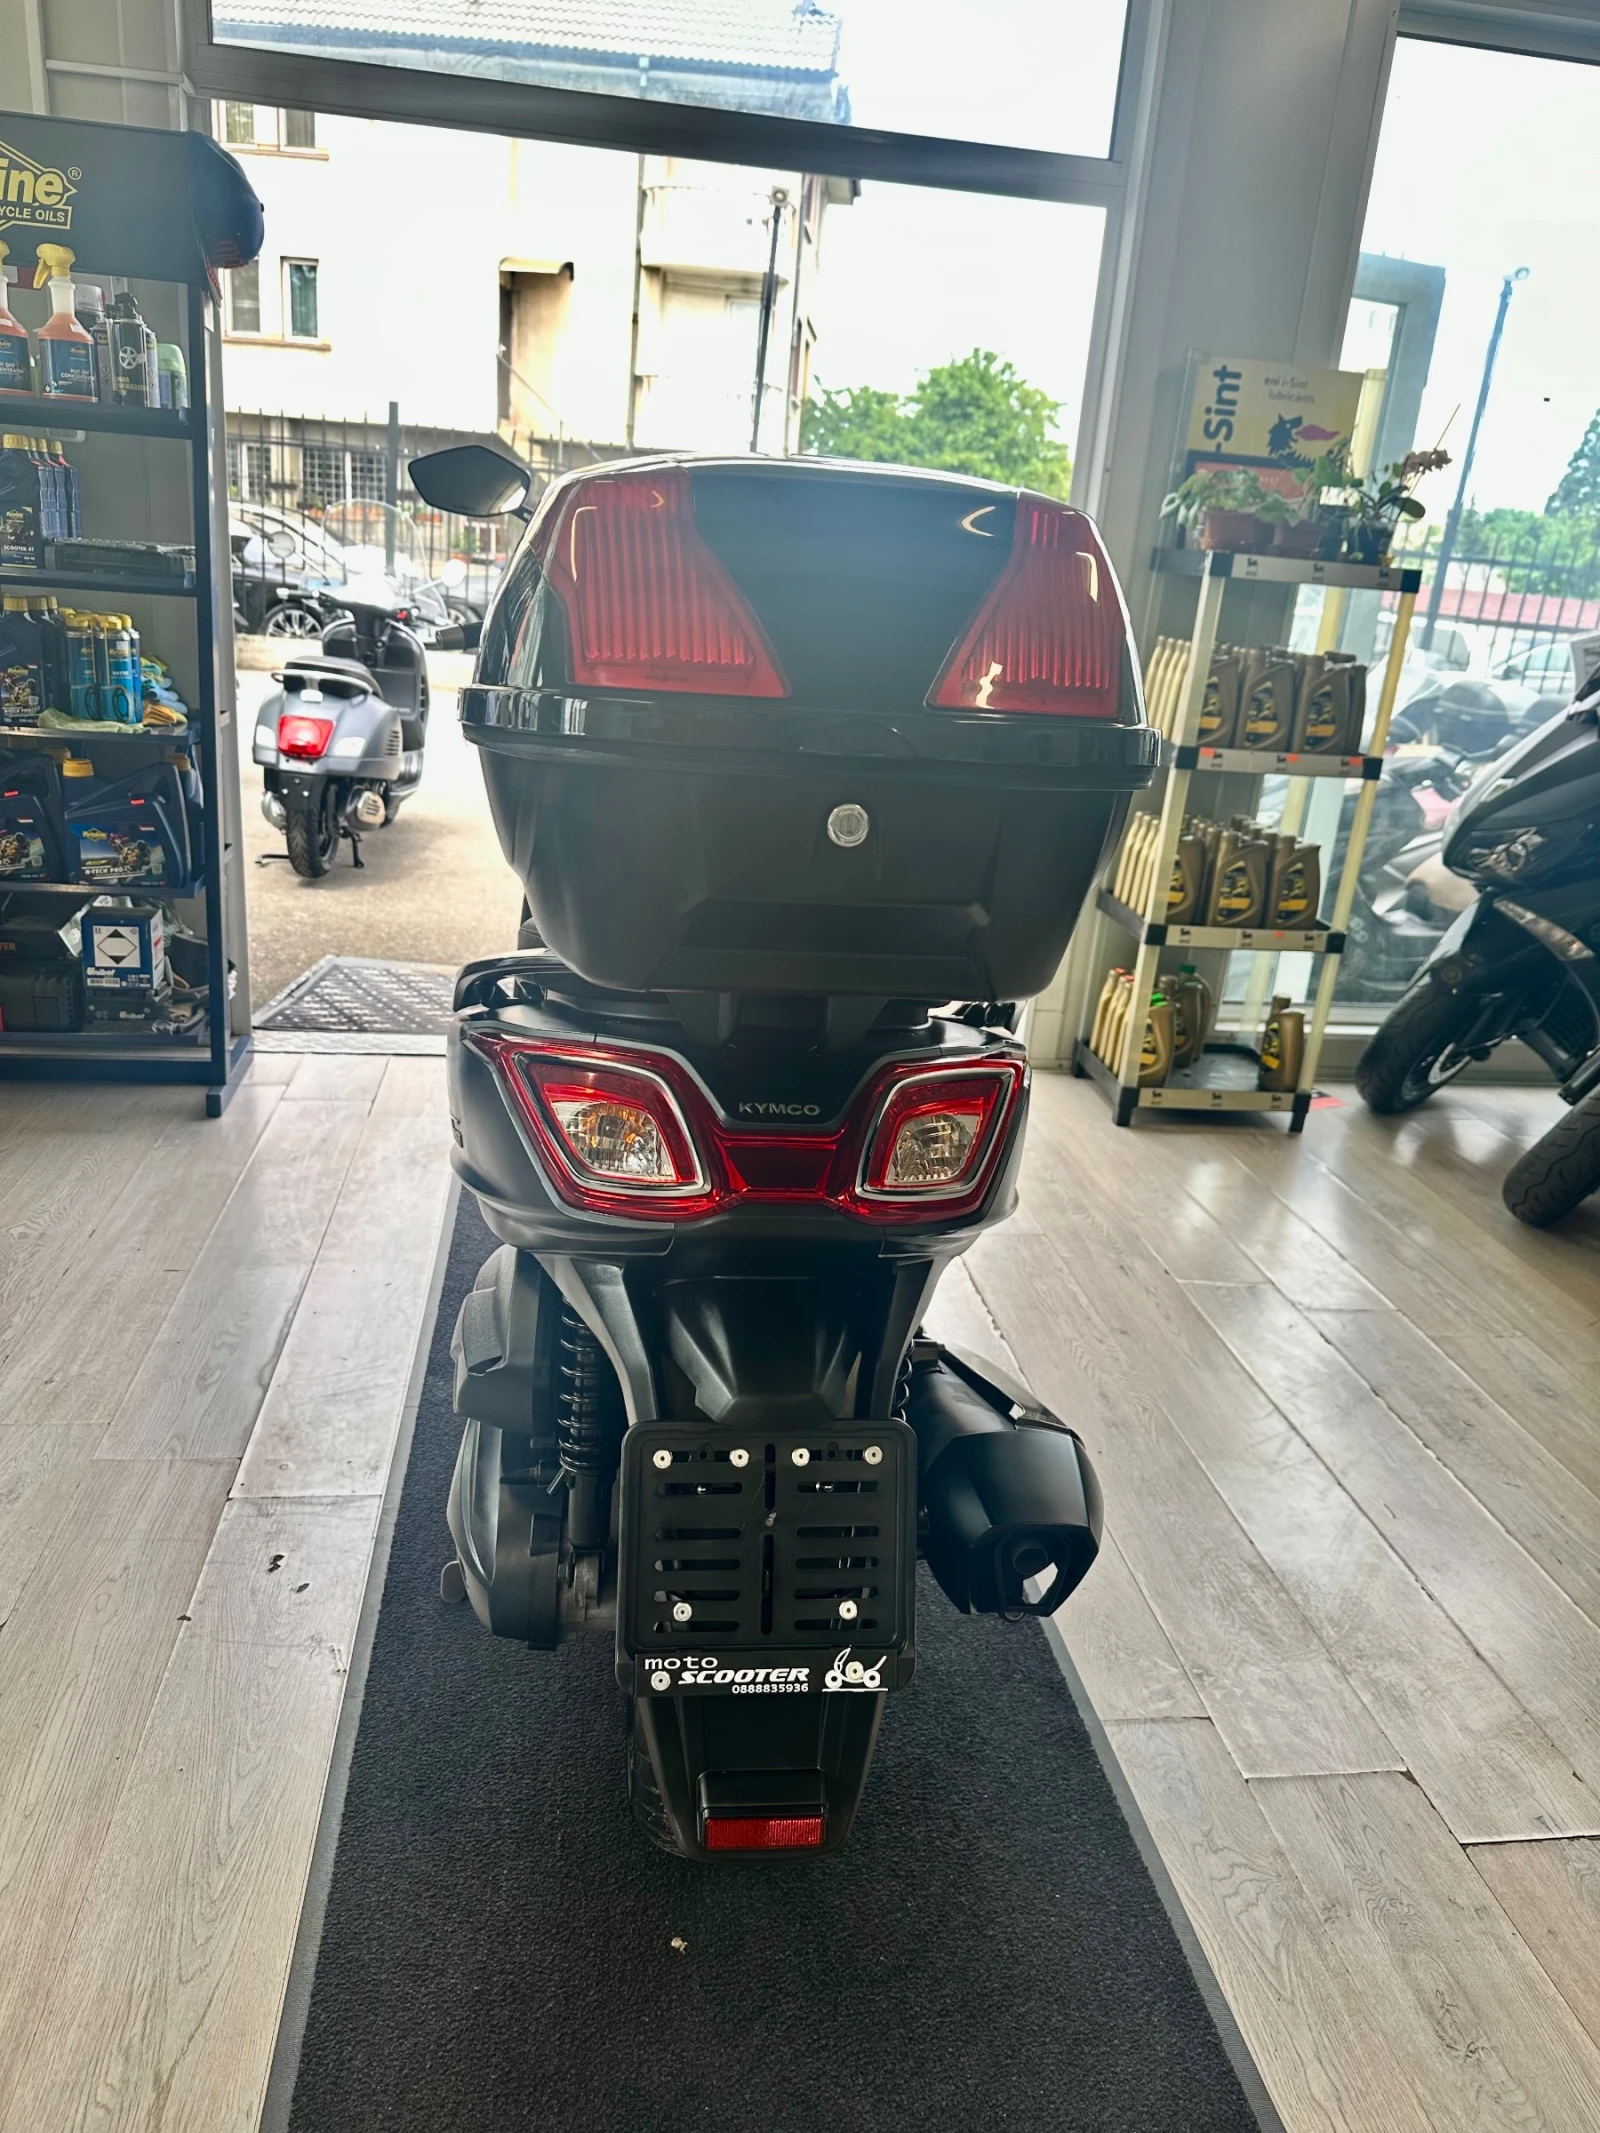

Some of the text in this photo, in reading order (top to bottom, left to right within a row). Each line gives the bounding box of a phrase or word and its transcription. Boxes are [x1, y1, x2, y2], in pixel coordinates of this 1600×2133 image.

[35, 209, 65, 222] OILS
[739, 1102, 820, 1116] KYMCO
[644, 1656, 718, 1670] moto
[678, 1668, 810, 1685] SCOOTER
[731, 1683, 809, 1694] 0888835936
